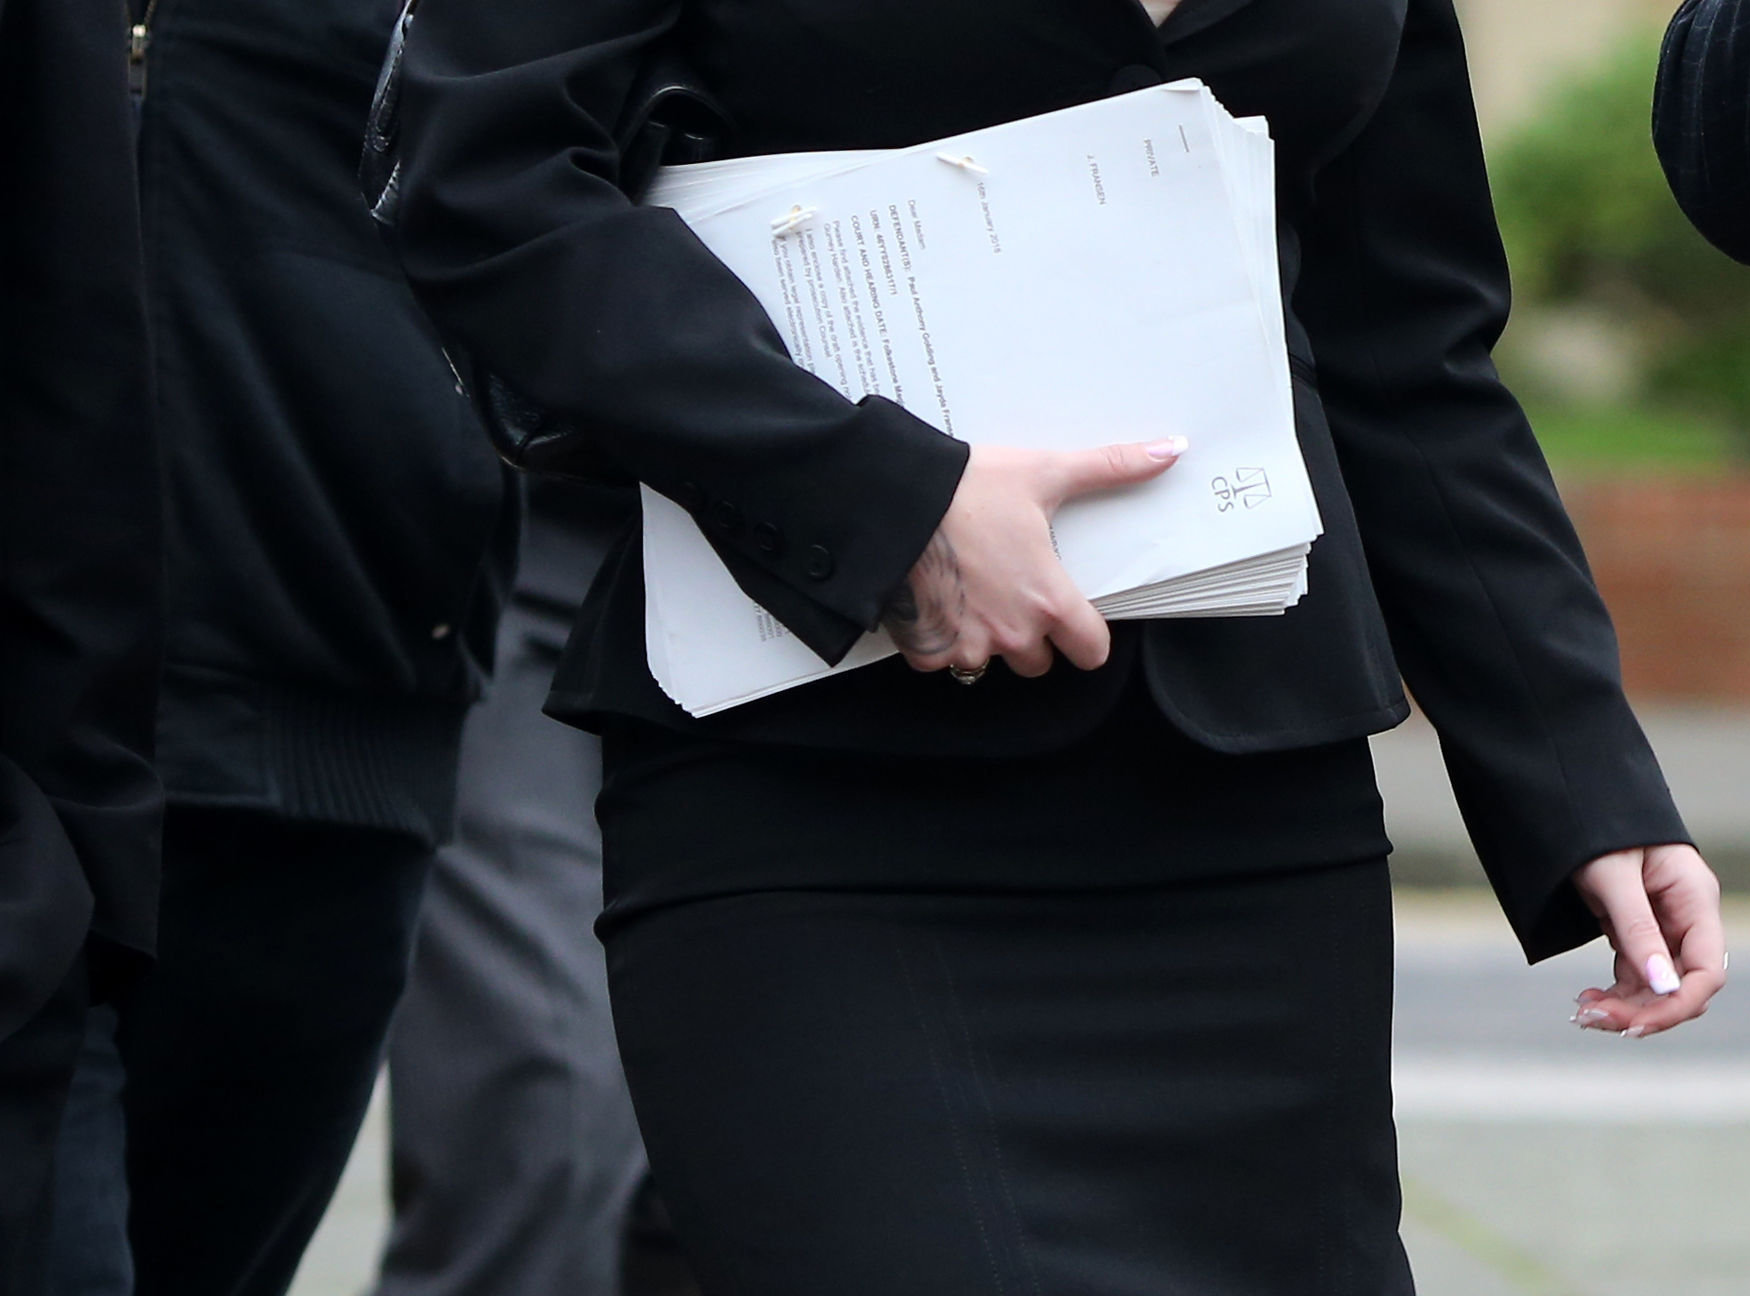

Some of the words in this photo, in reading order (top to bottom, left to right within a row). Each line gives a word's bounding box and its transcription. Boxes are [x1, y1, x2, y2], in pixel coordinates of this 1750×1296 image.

[1144, 139, 1159, 177] PRIVATE
[1089, 163, 1106, 205] FRANSEN
[851, 215, 865, 245] COURT
[908, 199, 918, 218] Dear
[914, 221, 926, 250] Madam
[981, 201, 994, 232] January
[889, 204, 911, 271] DEFENDANT(S):
[859, 249, 870, 267] AND
[806, 279, 823, 324] prosecution
[833, 220, 843, 247] Please
[843, 266, 857, 299] attached
[855, 315, 869, 349] evidence
[864, 268, 880, 309] HEARING
[907, 276, 918, 295] Paul
[811, 251, 822, 281] enclose
[831, 354, 848, 385] opening
[843, 306, 857, 339] attached
[875, 310, 887, 334] DATE:
[913, 297, 926, 331] Anthony
[792, 306, 813, 361] representation
[922, 332, 935, 365] Golding
[882, 339, 898, 384] Folkestone
[931, 367, 941, 382] and
[935, 384, 946, 408] Jayda
[1211, 476, 1234, 512] CPS
